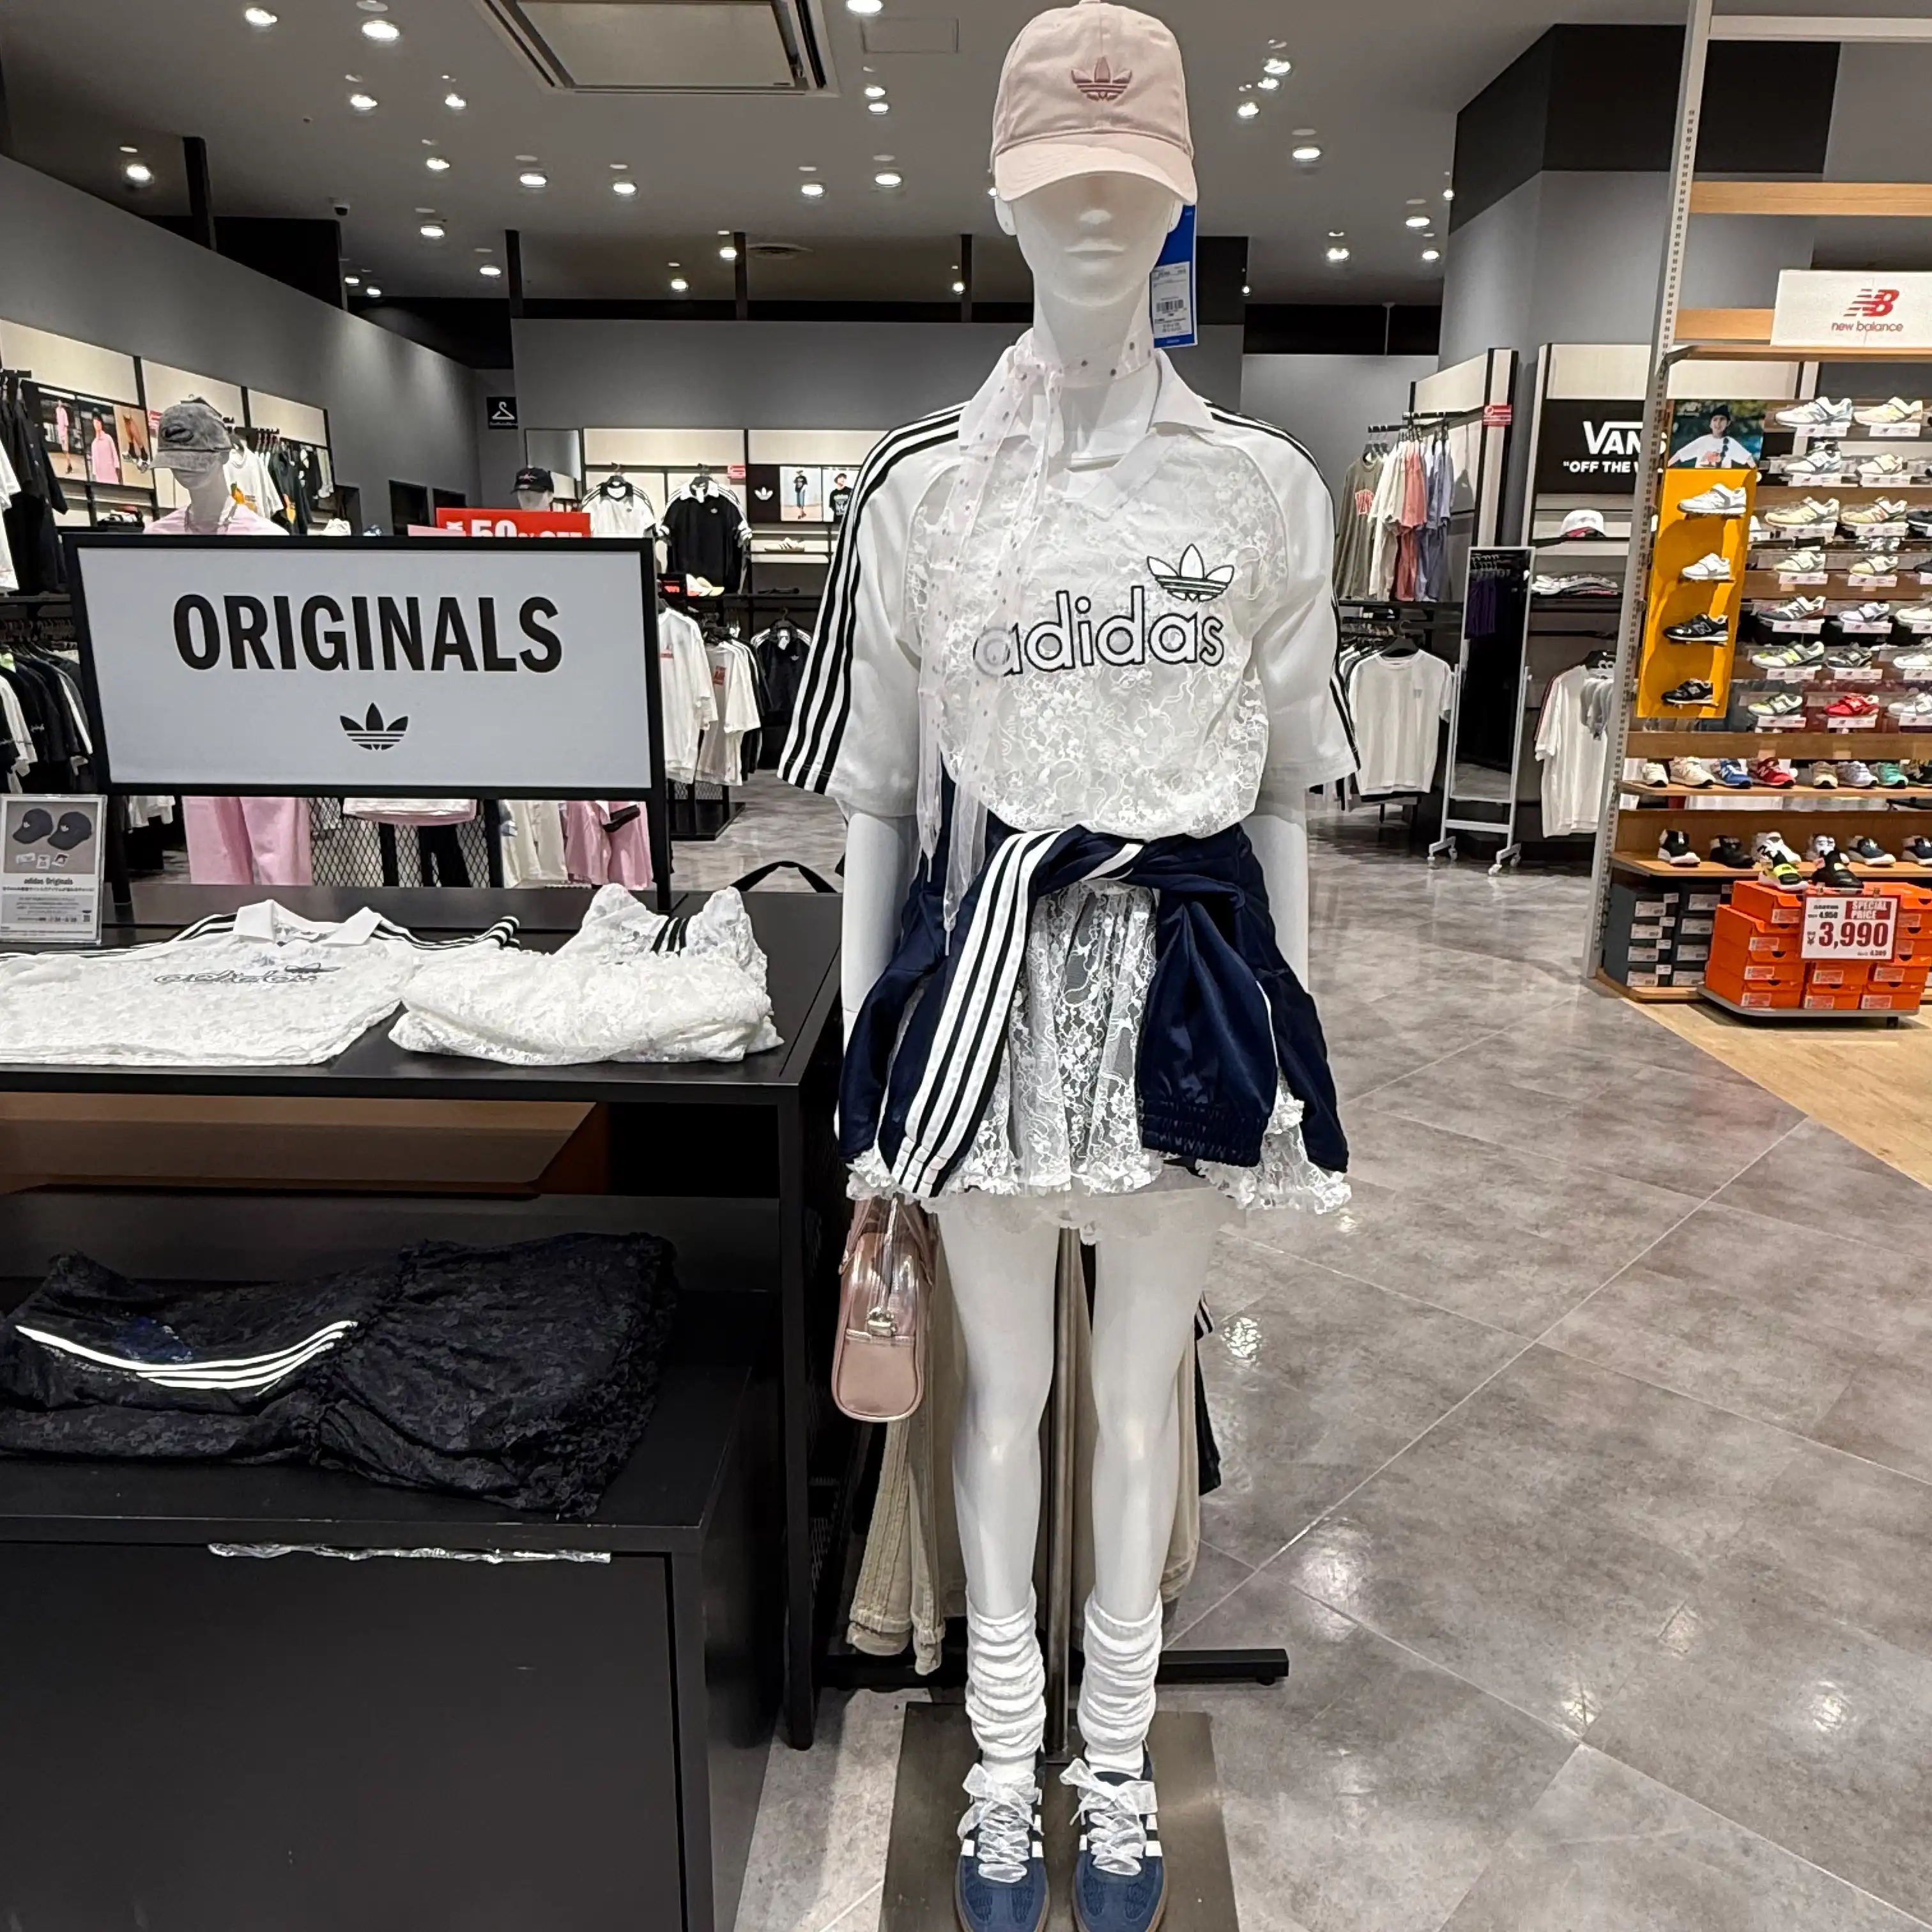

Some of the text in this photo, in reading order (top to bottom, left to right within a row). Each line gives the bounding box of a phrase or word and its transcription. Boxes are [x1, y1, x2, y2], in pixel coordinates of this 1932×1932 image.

[1832, 321, 1904, 332] new balance
[1602, 461, 1630, 473] THE
[173, 594, 563, 673] ORIGINALS
[972, 585, 1225, 677] adidas
[1852, 901, 1888, 910] SPECIAL
[1851, 910, 1876, 919] PRICE
[1819, 921, 1889, 949] 3,990
